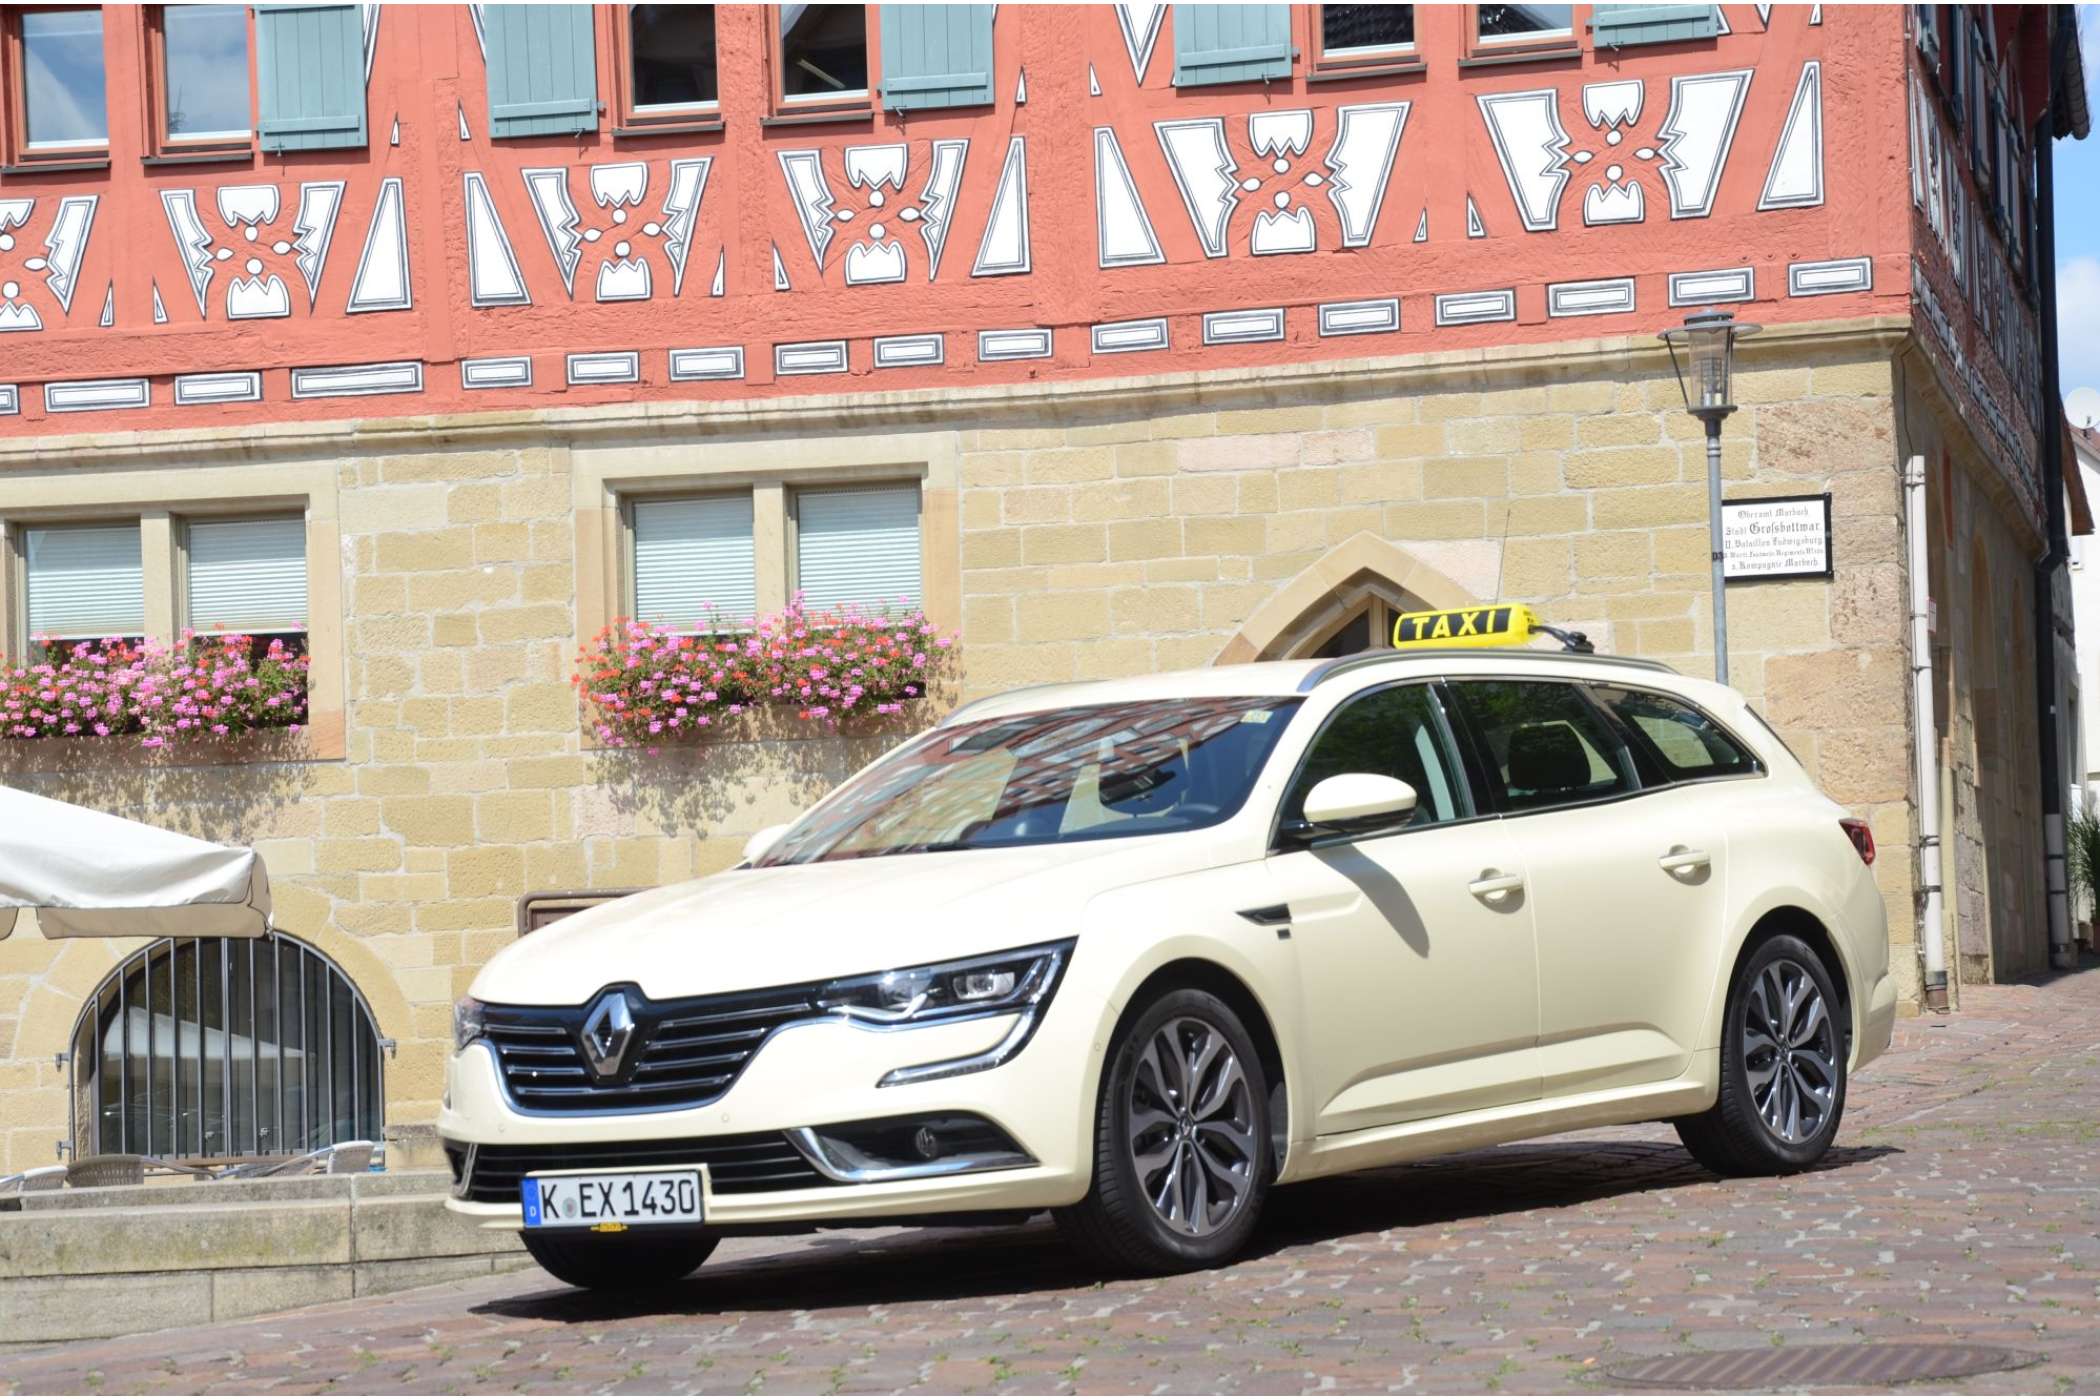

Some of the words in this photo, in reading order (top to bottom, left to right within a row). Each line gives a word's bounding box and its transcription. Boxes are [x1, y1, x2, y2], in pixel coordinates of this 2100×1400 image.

[1775, 506, 1808, 517] Marbach
[1413, 610, 1496, 640] TAXI
[529, 1206, 537, 1217] D
[541, 1184, 560, 1218] K
